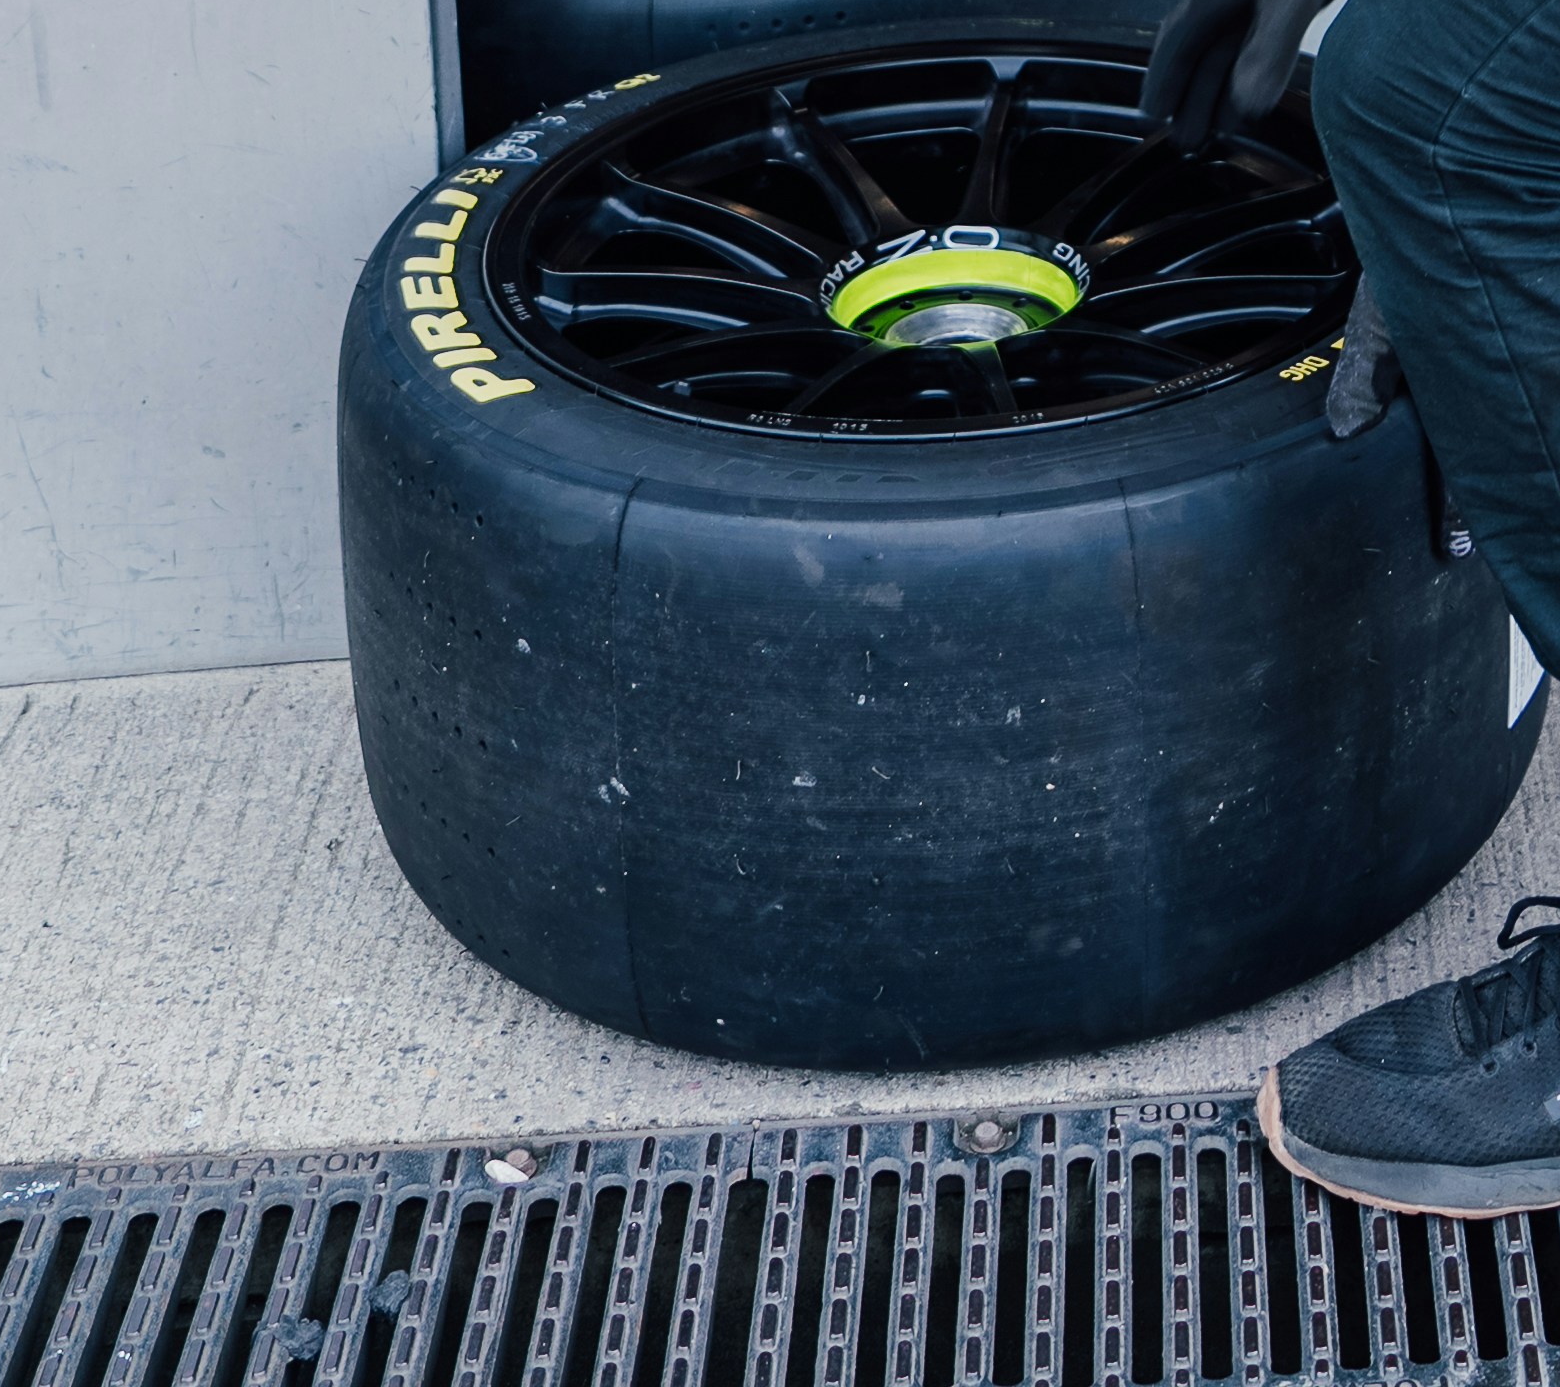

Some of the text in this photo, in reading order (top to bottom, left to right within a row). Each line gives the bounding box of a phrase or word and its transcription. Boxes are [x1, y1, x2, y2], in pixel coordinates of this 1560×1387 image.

[399, 188, 536, 404] PIRELLI
[1278, 354, 1330, 384] DHG
[1109, 1100, 1220, 1129] F900
[64, 1149, 381, 1191] POLYALFA.COM
